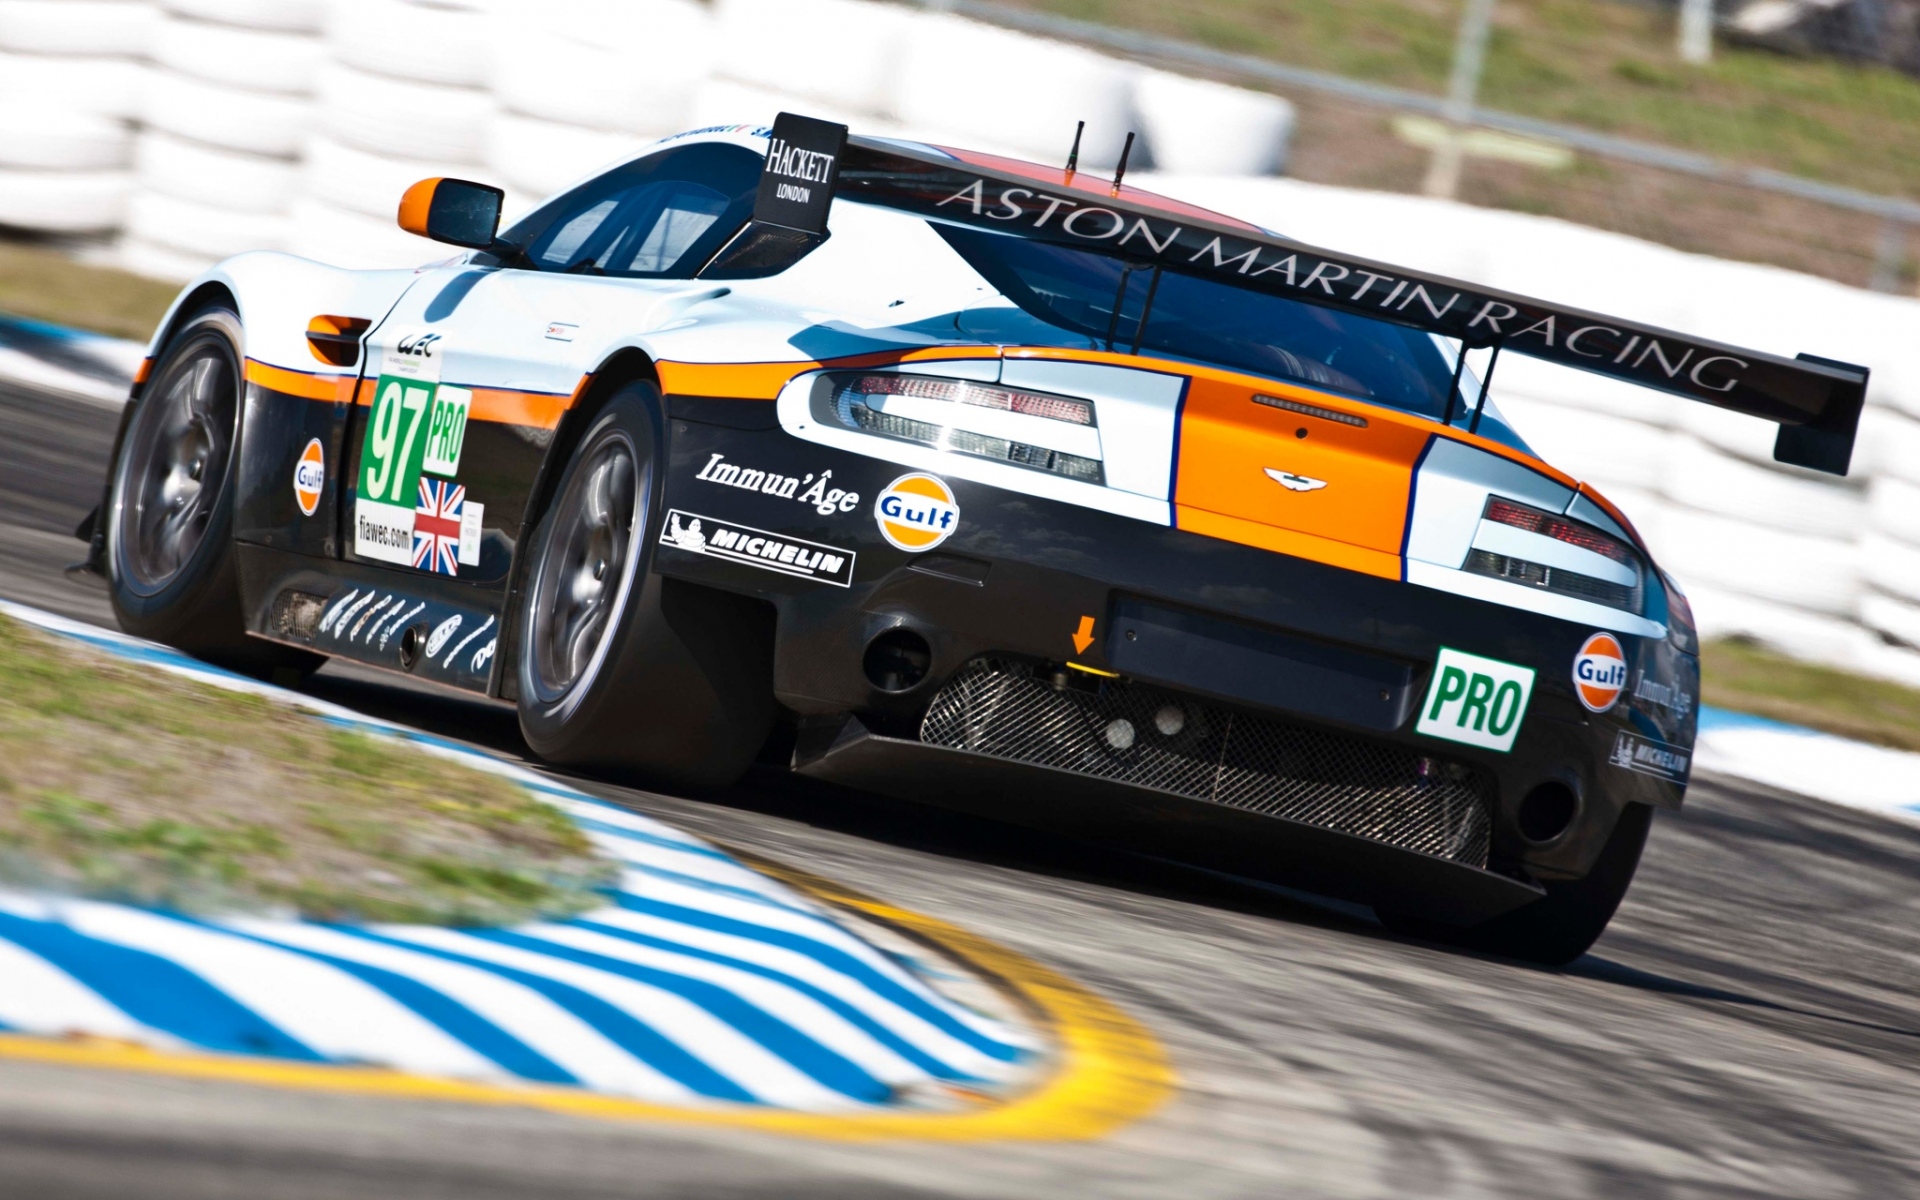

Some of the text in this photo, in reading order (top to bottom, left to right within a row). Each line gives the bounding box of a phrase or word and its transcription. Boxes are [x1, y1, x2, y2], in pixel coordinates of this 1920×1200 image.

[766, 138, 834, 184] HACKETT
[776, 183, 811, 204] LONDON
[936, 179, 1750, 393] ASTON MARTIN RACING
[366, 381, 429, 502] 97
[426, 399, 466, 464] PRO
[297, 465, 325, 491] Gulf
[695, 453, 861, 515] Immun'Âge
[359, 516, 411, 551] fiawec.com
[880, 496, 955, 530] Gulf
[709, 528, 845, 574] MICHELIN
[1577, 658, 1627, 686] Gulf
[1428, 665, 1523, 737] PRO
